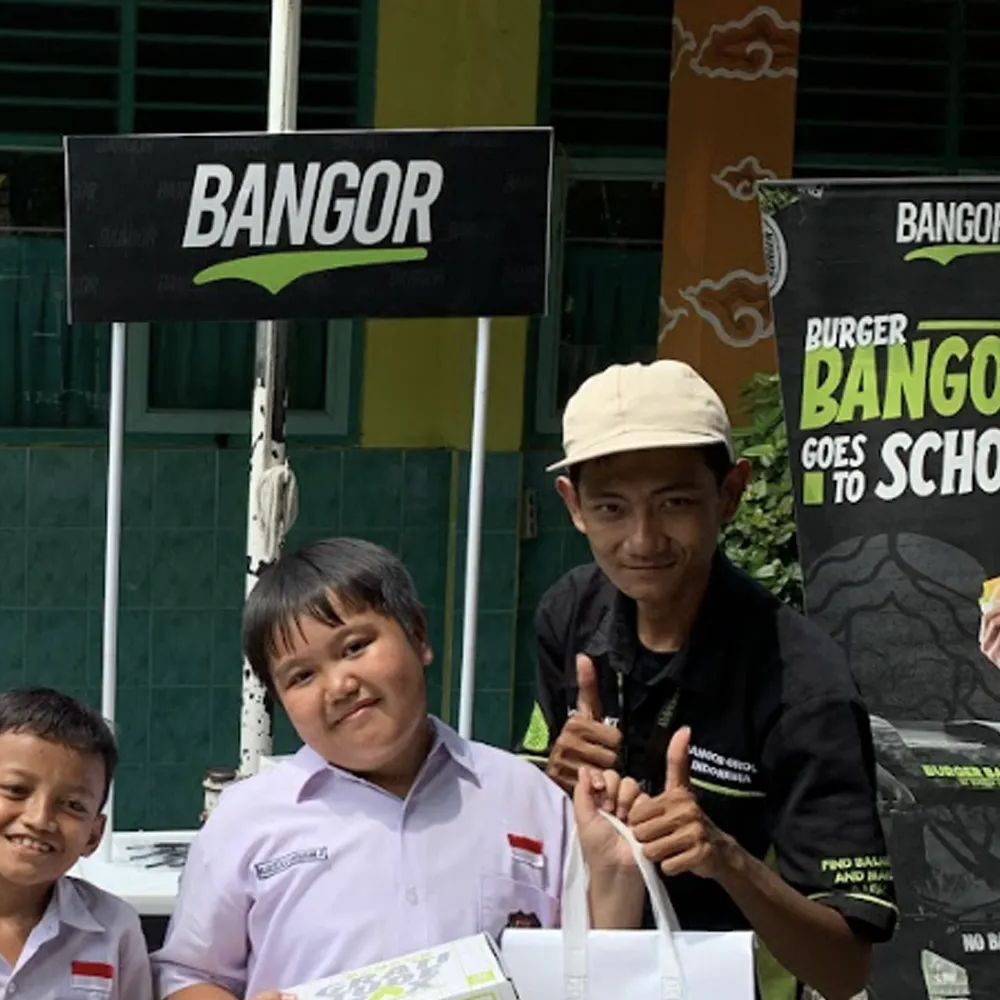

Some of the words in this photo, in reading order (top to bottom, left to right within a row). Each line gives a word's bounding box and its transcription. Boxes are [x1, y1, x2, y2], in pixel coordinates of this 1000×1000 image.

[182, 160, 444, 248] BANGOR
[805, 313, 909, 351] BURGER
[801, 433, 868, 470] GOES
[832, 470, 866, 504] TO
[921, 764, 982, 778] BURGER
[962, 933, 985, 953] NO
